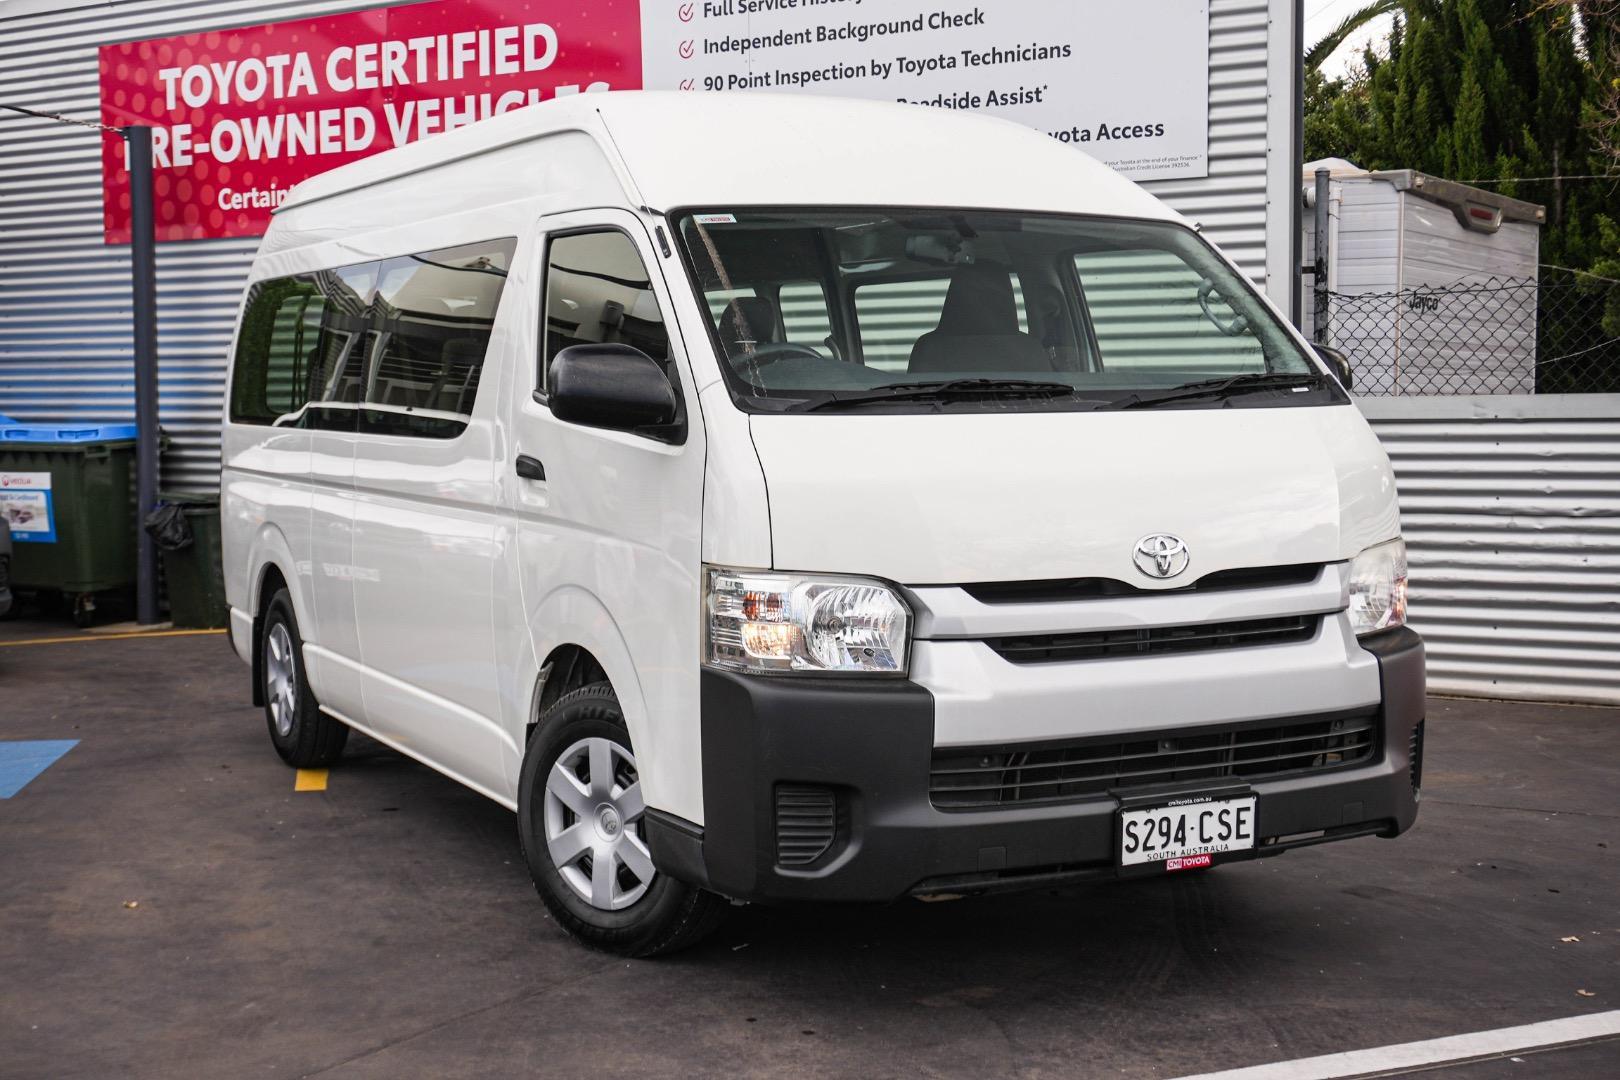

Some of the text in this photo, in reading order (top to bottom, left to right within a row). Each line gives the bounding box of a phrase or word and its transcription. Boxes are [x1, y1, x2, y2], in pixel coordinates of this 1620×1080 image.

[703, 0, 735, 18] Full
[738, 0, 798, 14] Service
[703, 8, 985, 55] Independent Background Check
[159, 23, 559, 111] TOYOTA CERTIFIED
[703, 43, 1072, 91] 90 Point Inspection by Toyota Technicians
[1096, 123, 1165, 141] Access
[1409, 291, 1439, 315] Jayco
[1146, 843, 1229, 862] SOUTH AUSTRALIA
[1182, 855, 1211, 867] TOYOTA
